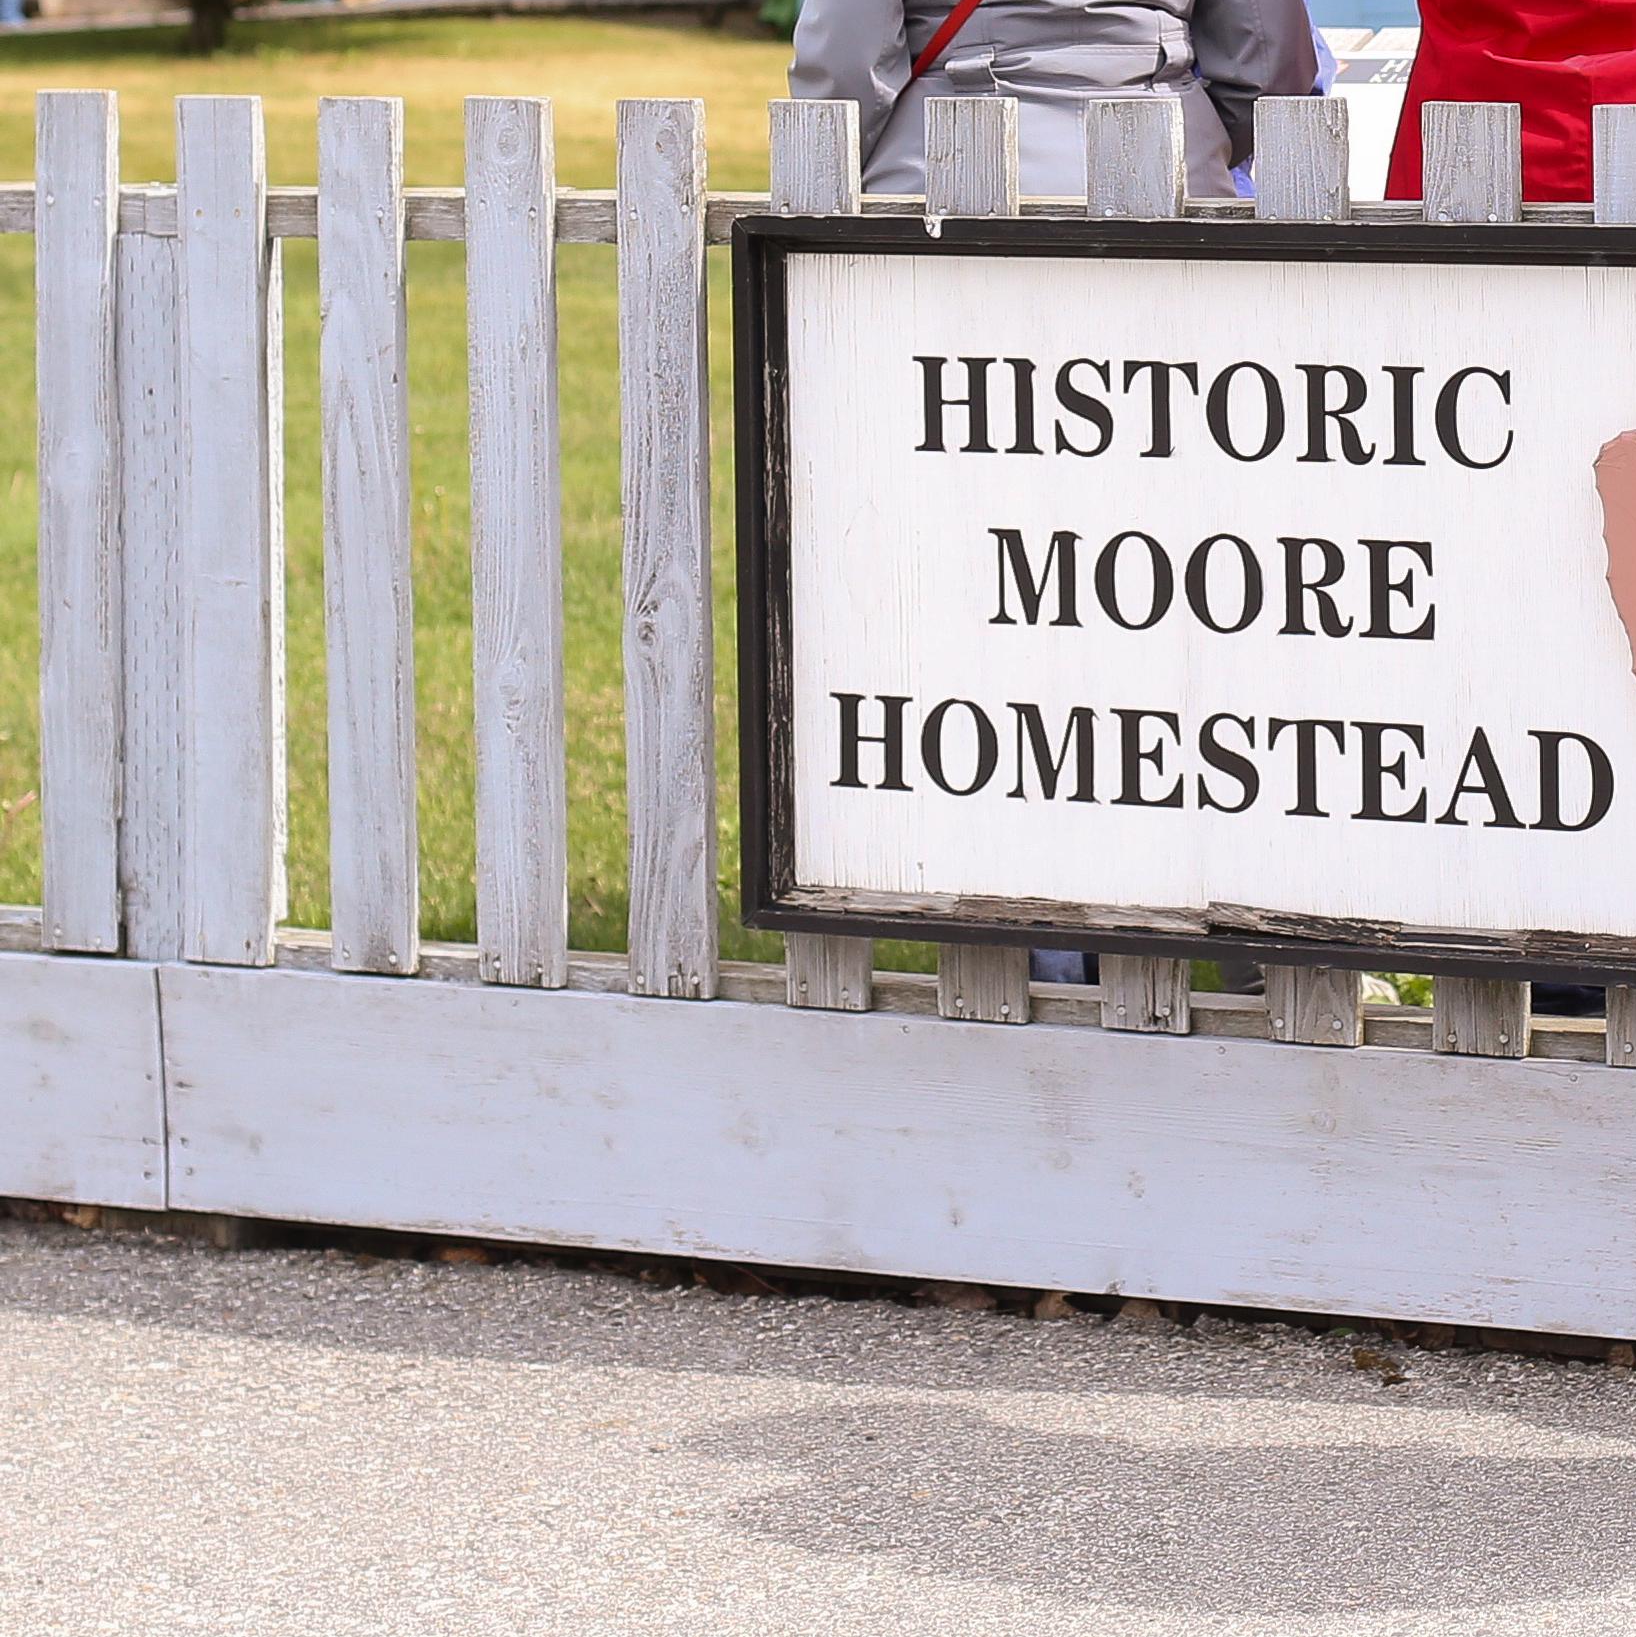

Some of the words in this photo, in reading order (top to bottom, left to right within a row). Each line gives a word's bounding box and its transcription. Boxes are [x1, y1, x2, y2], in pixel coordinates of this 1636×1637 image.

[912, 355, 1514, 470] HISTORIC
[987, 528, 1436, 641] MOORE
[829, 692, 1615, 832] HOMESTEAD
